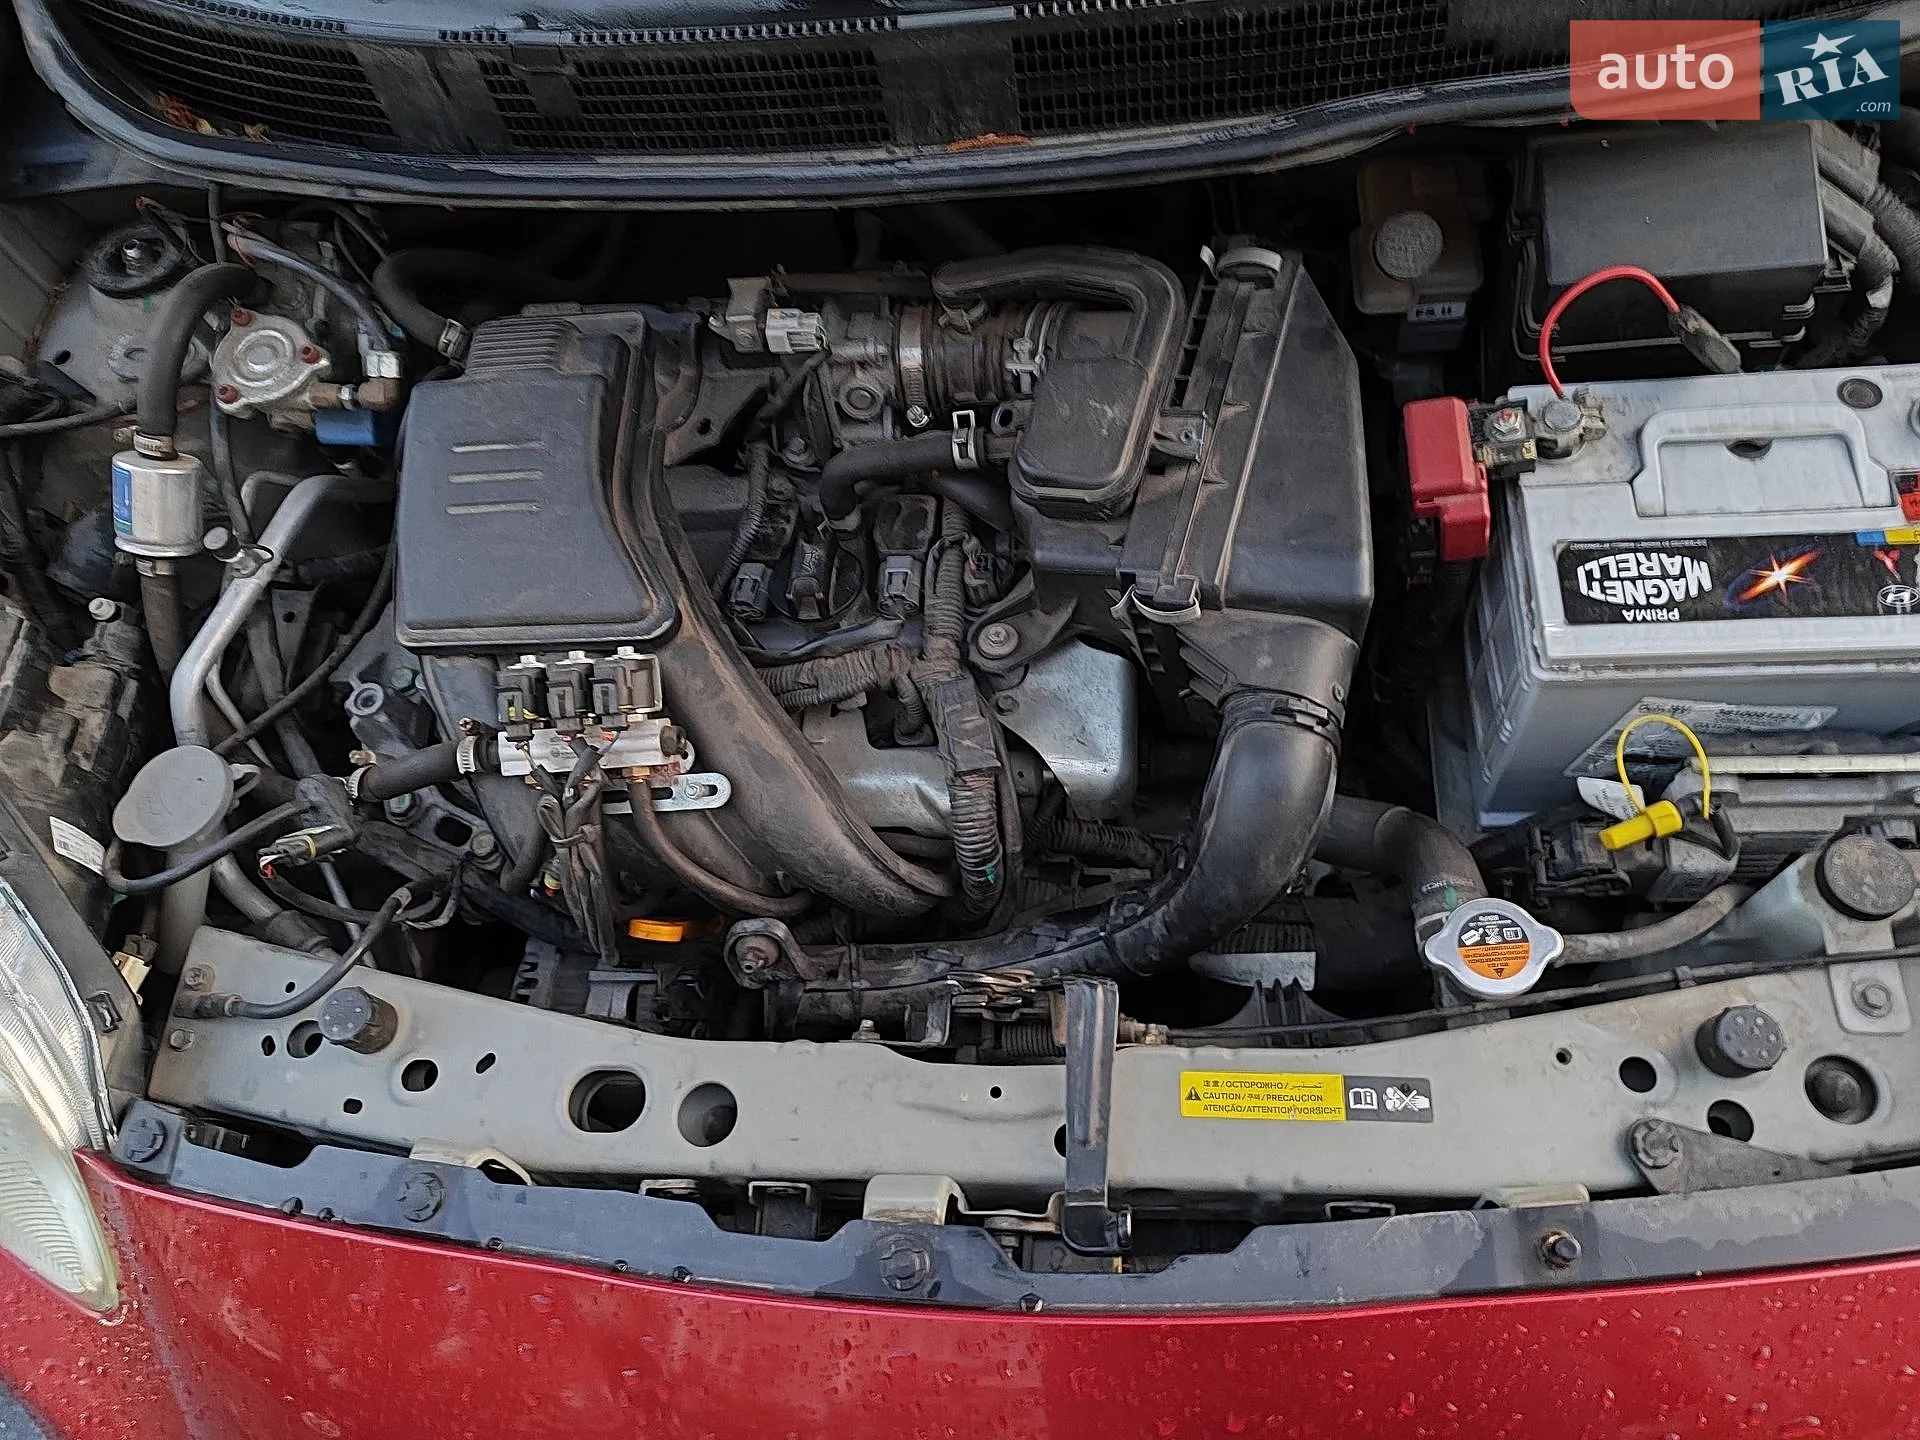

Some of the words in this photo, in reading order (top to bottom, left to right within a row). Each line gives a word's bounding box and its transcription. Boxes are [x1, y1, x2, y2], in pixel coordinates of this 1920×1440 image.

[1577, 552, 1713, 598] MARELLI
[1577, 556, 1713, 606] MAGNETI
[1621, 607, 1680, 622] PRIMA
